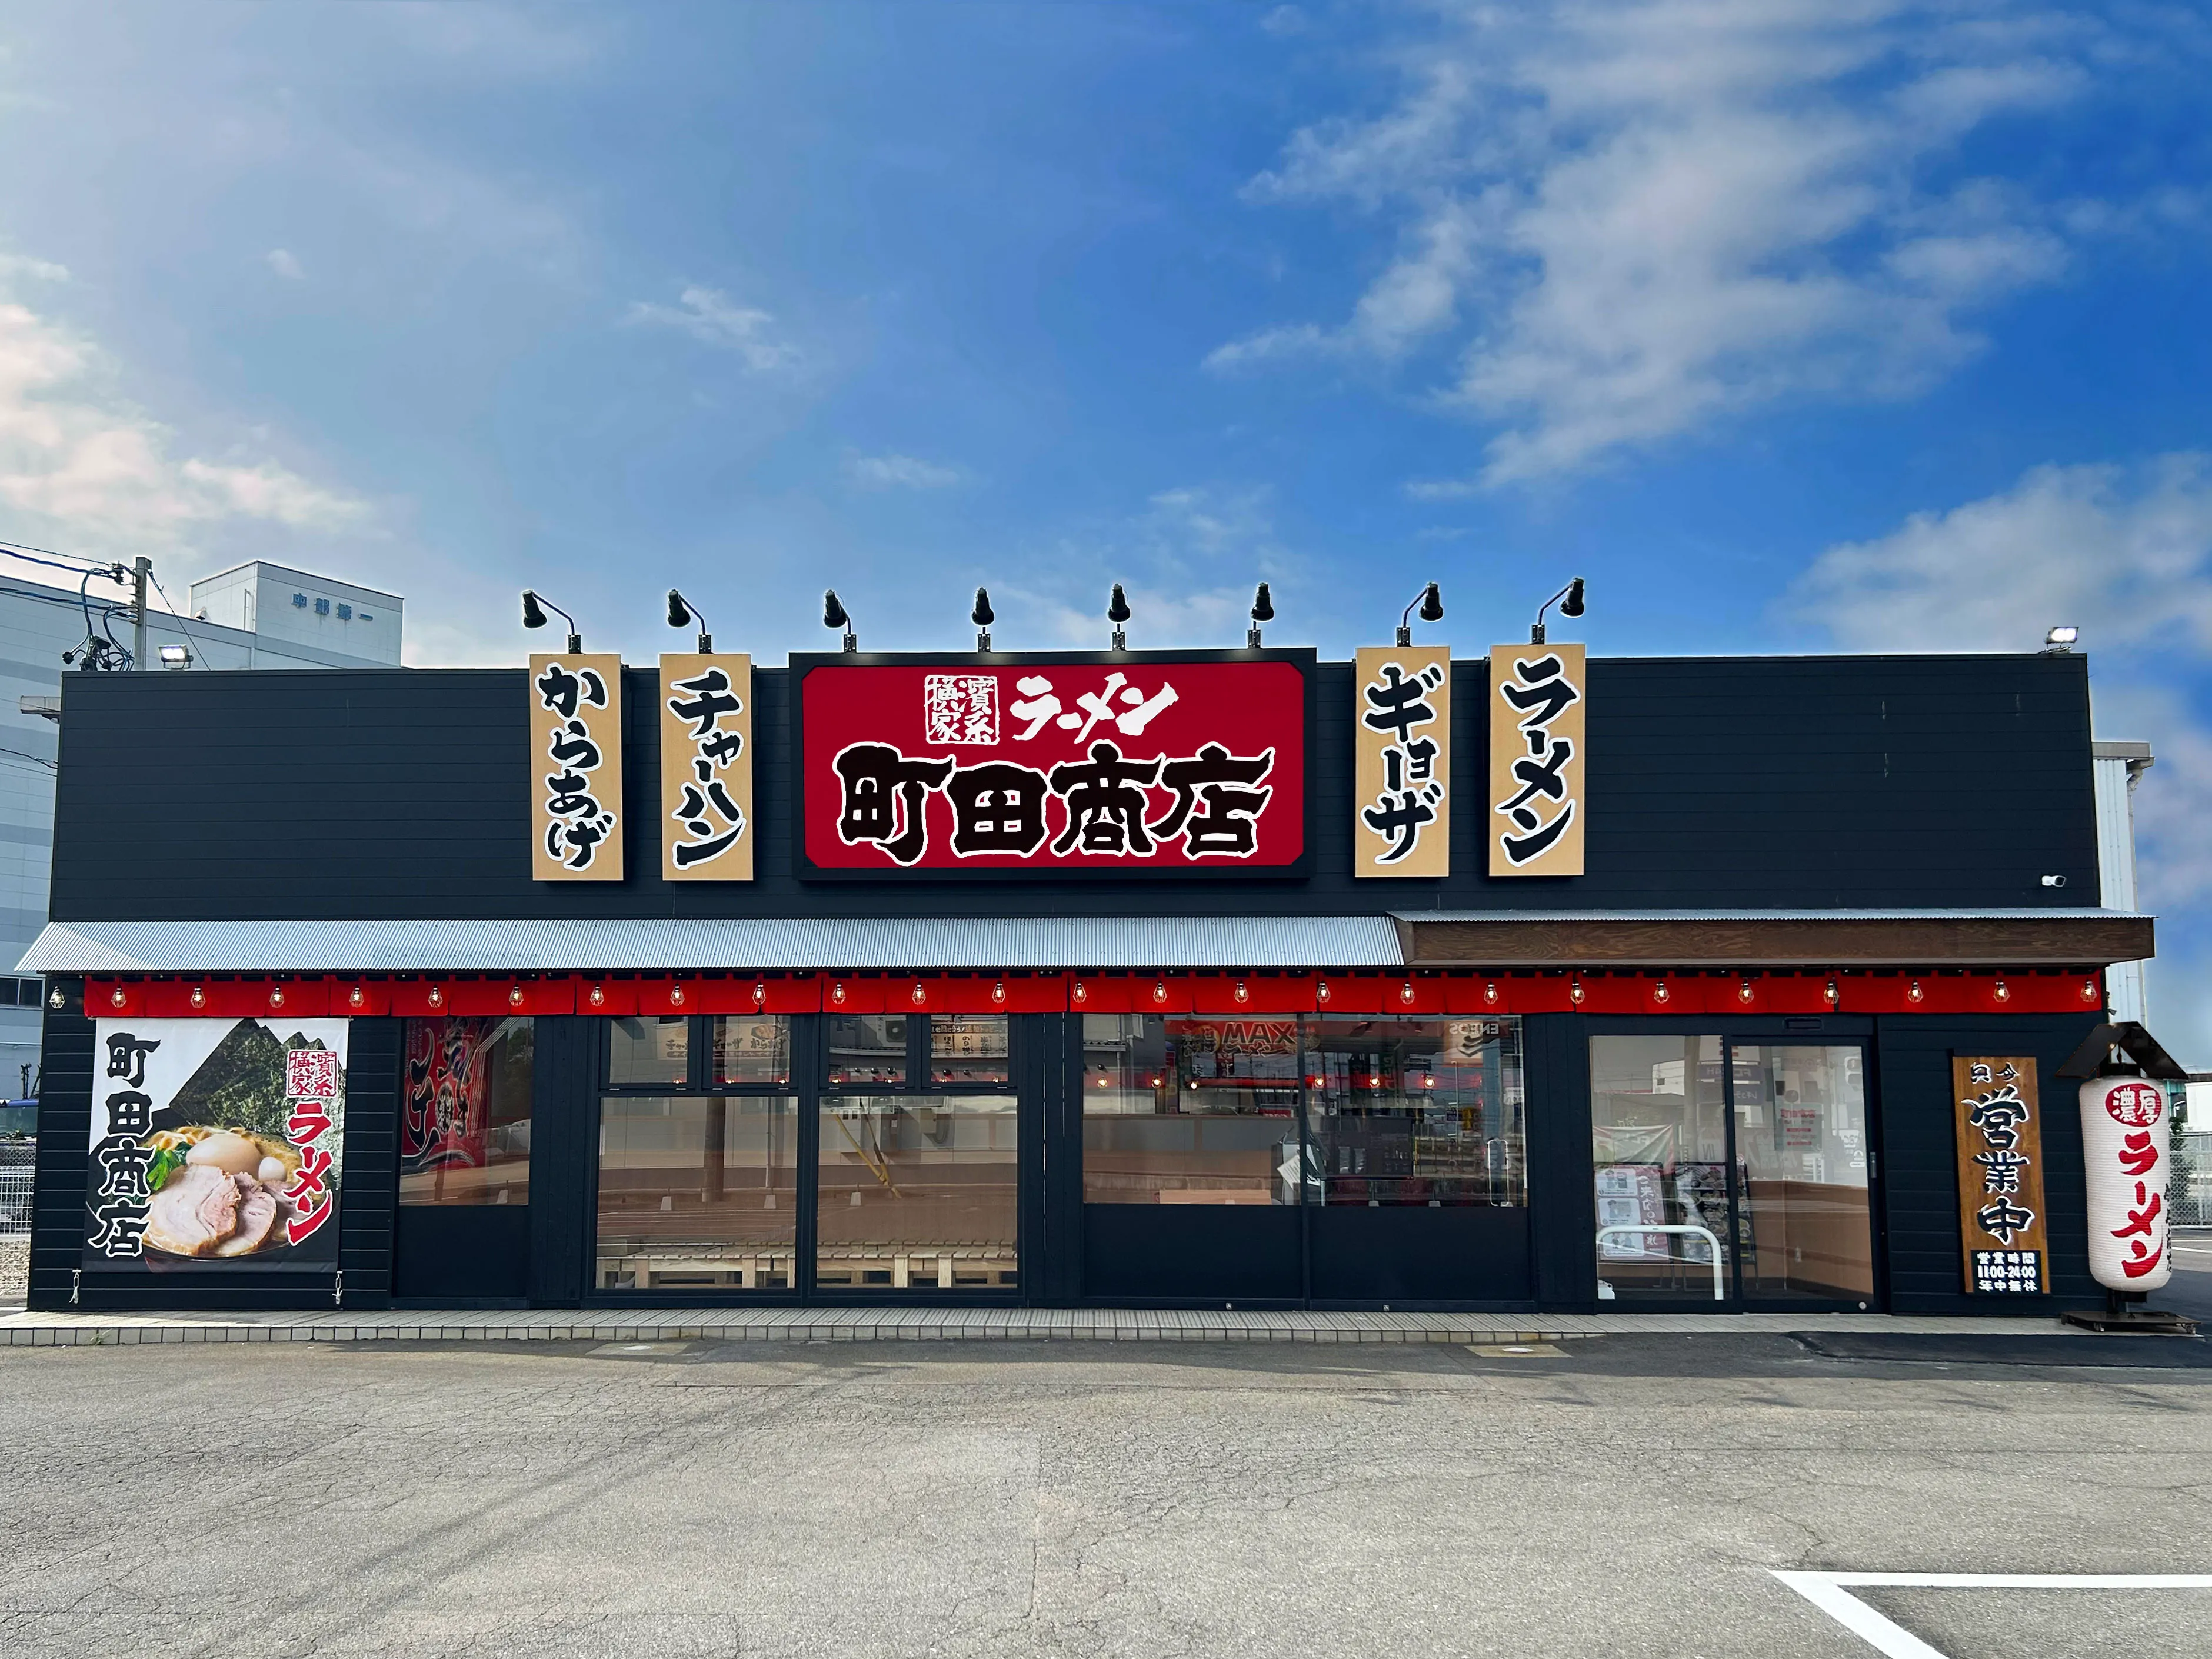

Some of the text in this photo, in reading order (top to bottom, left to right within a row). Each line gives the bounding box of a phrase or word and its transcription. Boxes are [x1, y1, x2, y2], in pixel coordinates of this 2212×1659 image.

[535, 662, 617, 872] からあげ
[667, 666, 747, 870] チャーハン
[1009, 672, 1180, 744] ラーメン
[1360, 662, 1445, 865] ギョーザ
[1494, 652, 1581, 867] ラーメン
[832, 740, 1275, 867] 町田商店
[1222, 1022, 1297, 1045] MAX
[2112, 1087, 2158, 1124] 濃厚
[88, 1032, 161, 1258] 町田商店
[281, 1101, 334, 1247] ラーメン
[1961, 1084, 2035, 1246] 営業中
[2110, 1131, 2164, 1278] ラーメン
[1977, 1252, 2036, 1264] 営業時間
[1978, 1280, 2037, 1292] 年中無休
